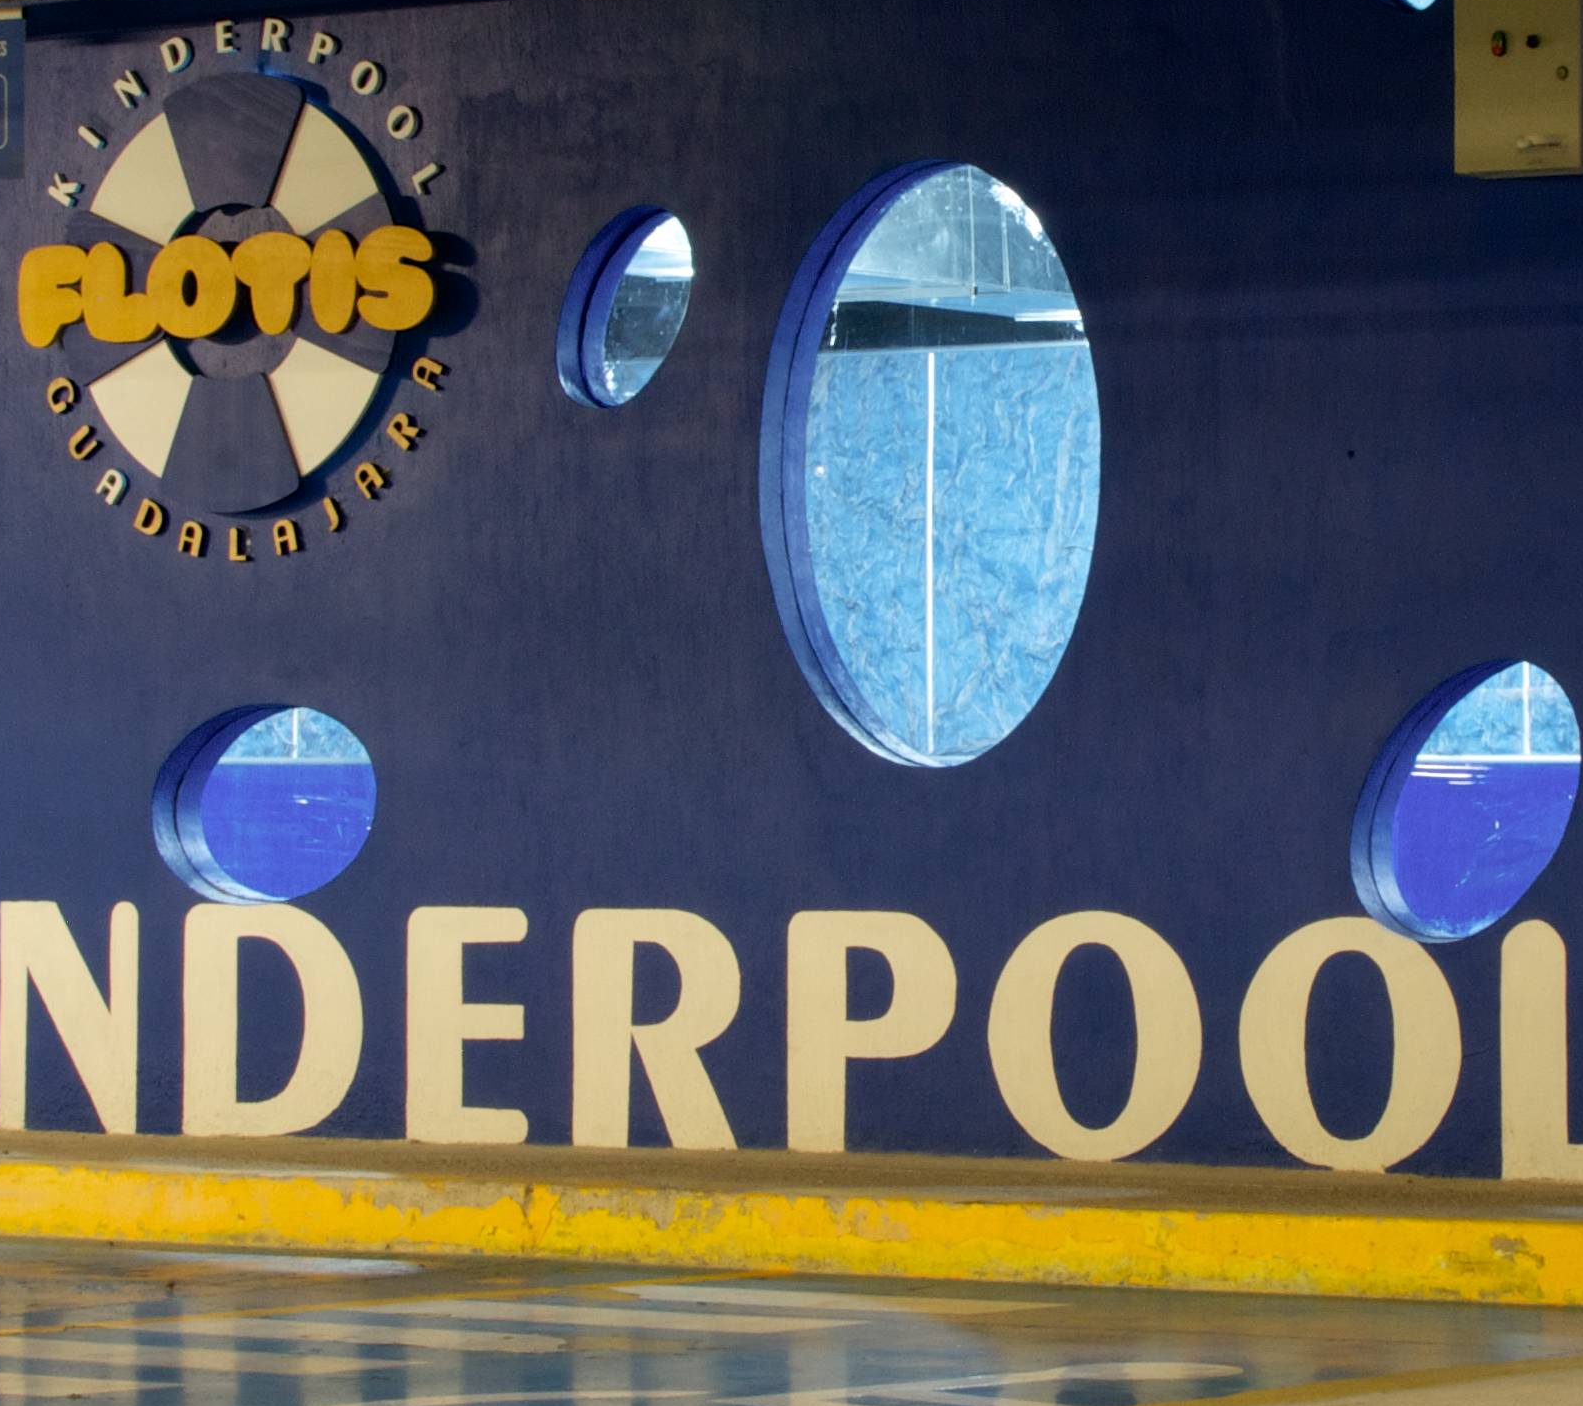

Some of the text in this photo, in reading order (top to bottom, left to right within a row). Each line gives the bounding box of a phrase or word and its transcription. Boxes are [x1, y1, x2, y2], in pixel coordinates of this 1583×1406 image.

[47, 17, 446, 209] KINDERPOOL
[18, 225, 435, 349] FLOTIS
[46, 355, 450, 563] GUADALAJARA
